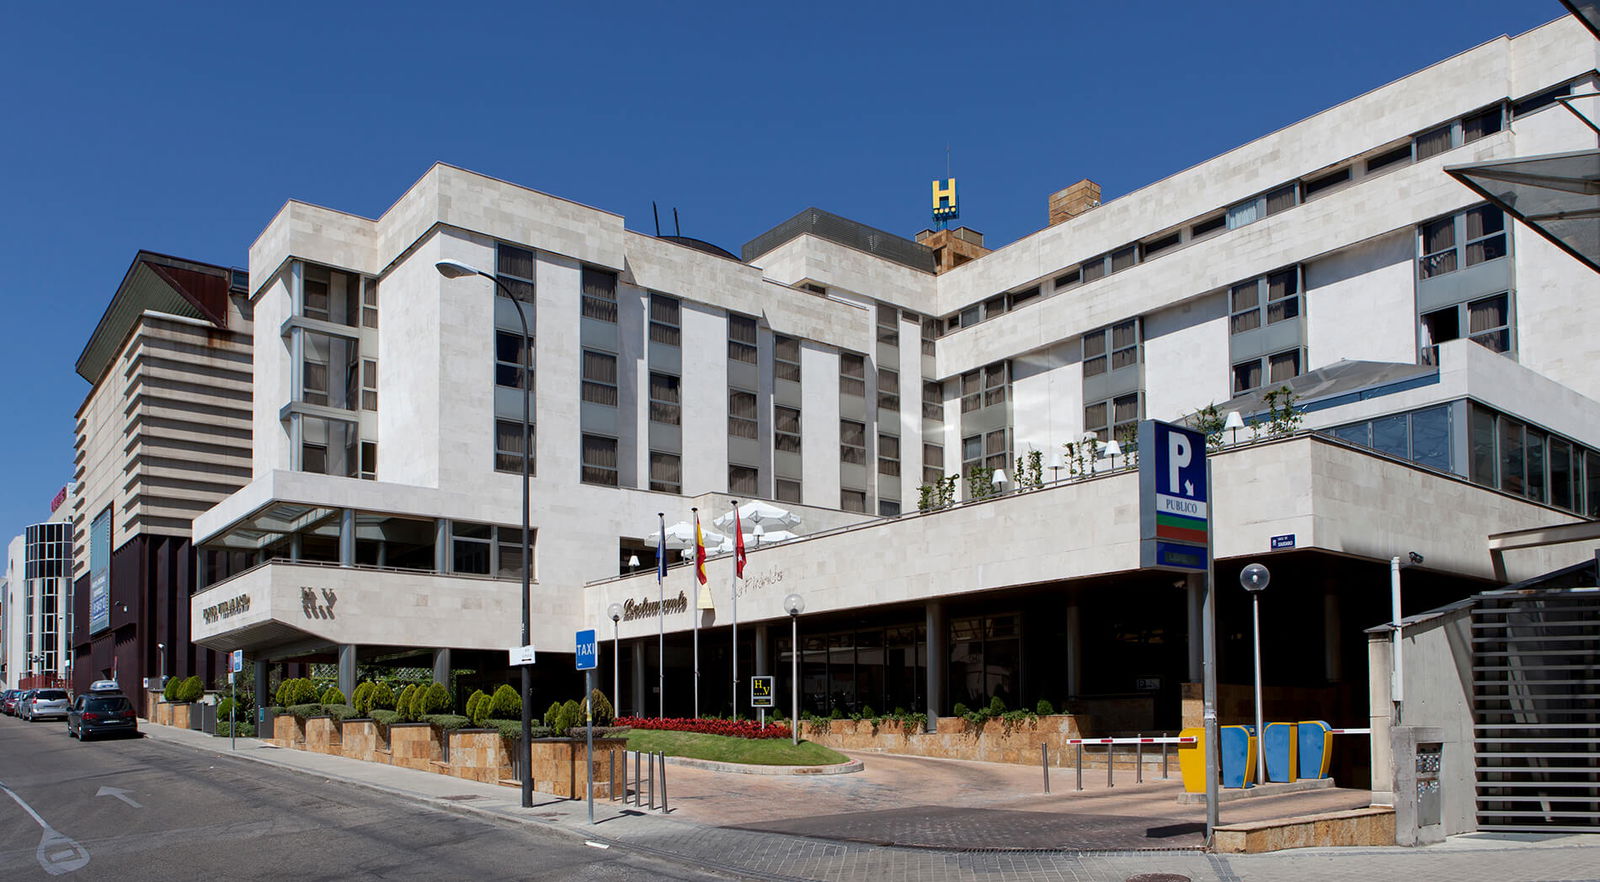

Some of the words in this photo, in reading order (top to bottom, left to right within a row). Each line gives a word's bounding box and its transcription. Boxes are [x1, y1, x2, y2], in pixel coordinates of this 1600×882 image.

[932, 178, 956, 208] H
[1168, 430, 1192, 494] P
[1166, 498, 1198, 514] PUBLICO
[576, 642, 595, 656] TAXI
[754, 679, 763, 689] H
[762, 686, 770, 695] V
